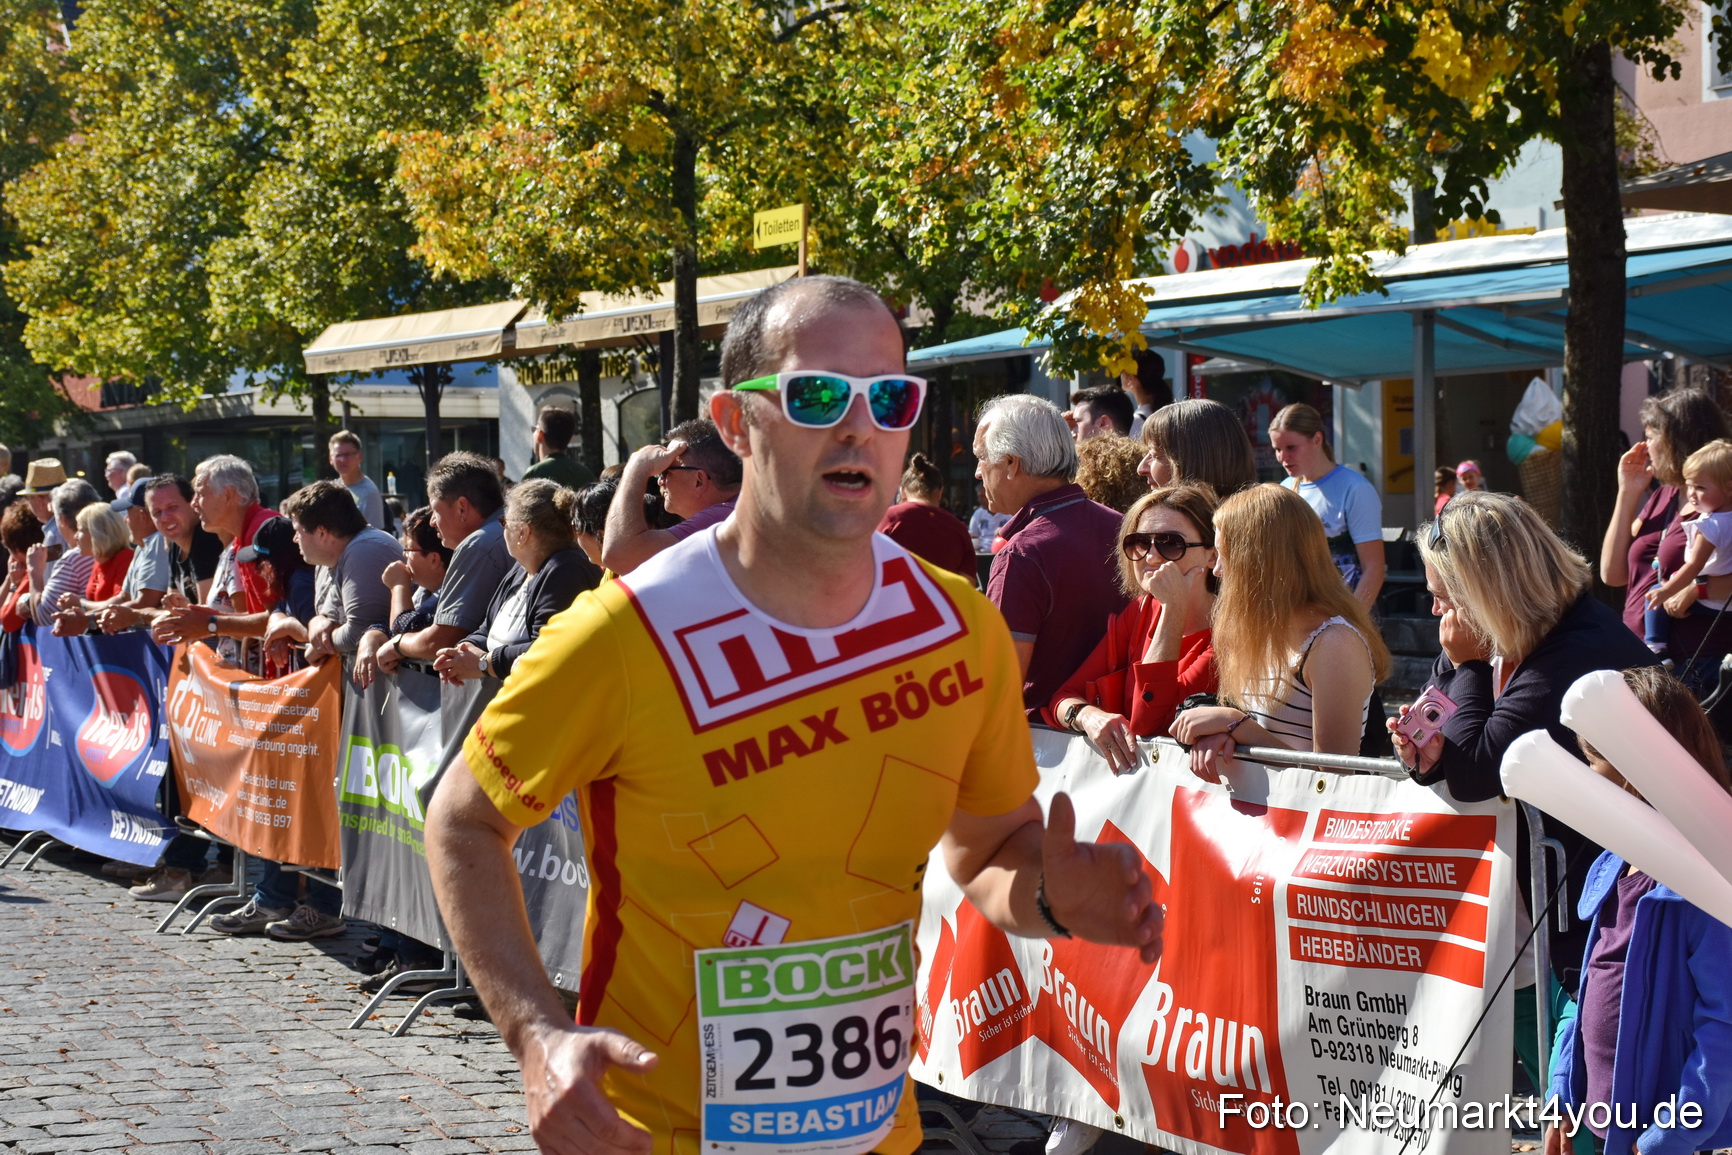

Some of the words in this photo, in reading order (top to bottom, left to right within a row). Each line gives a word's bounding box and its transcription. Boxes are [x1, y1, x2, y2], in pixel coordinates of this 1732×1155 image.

[762, 219, 800, 237] Toiletten
[195, 715, 222, 748] CLINIC
[268, 719, 304, 737] Internet,
[702, 706, 851, 788] MAX
[860, 659, 984, 734] BÖGL
[287, 741, 320, 759] angeht.
[265, 774, 278, 790] bei
[279, 780, 297, 792] uns:
[272, 815, 292, 828] 897
[1323, 817, 1414, 842] BINDESTRICKE
[1304, 854, 1458, 886] VERZURRSYSTEME
[1250, 874, 1265, 905] Seit
[1296, 893, 1448, 928] RUNDSCHLINGEN
[1299, 936, 1423, 968] HEBEBÄNDER
[719, 938, 904, 1005] BOCK
[950, 967, 1022, 1043] Braun
[1040, 938, 1112, 1064] Braun
[1304, 984, 1351, 1011] Braun
[1356, 990, 1408, 1016] GmbH
[978, 1023, 1002, 1042] Sicher
[1003, 1015, 1014, 1029] ist
[1143, 980, 1273, 1095] Braun
[1308, 1012, 1333, 1035] Am
[1336, 1014, 1410, 1050] Grünberg
[1412, 1024, 1420, 1047] 8
[732, 1004, 903, 1092] 2386
[1067, 1025, 1087, 1057] Sicher
[1088, 1049, 1099, 1067] ist
[1310, 1038, 1375, 1065] D-92318
[1350, 1078, 1387, 1106] 09181
[729, 1086, 898, 1136] SEBASTIAN
